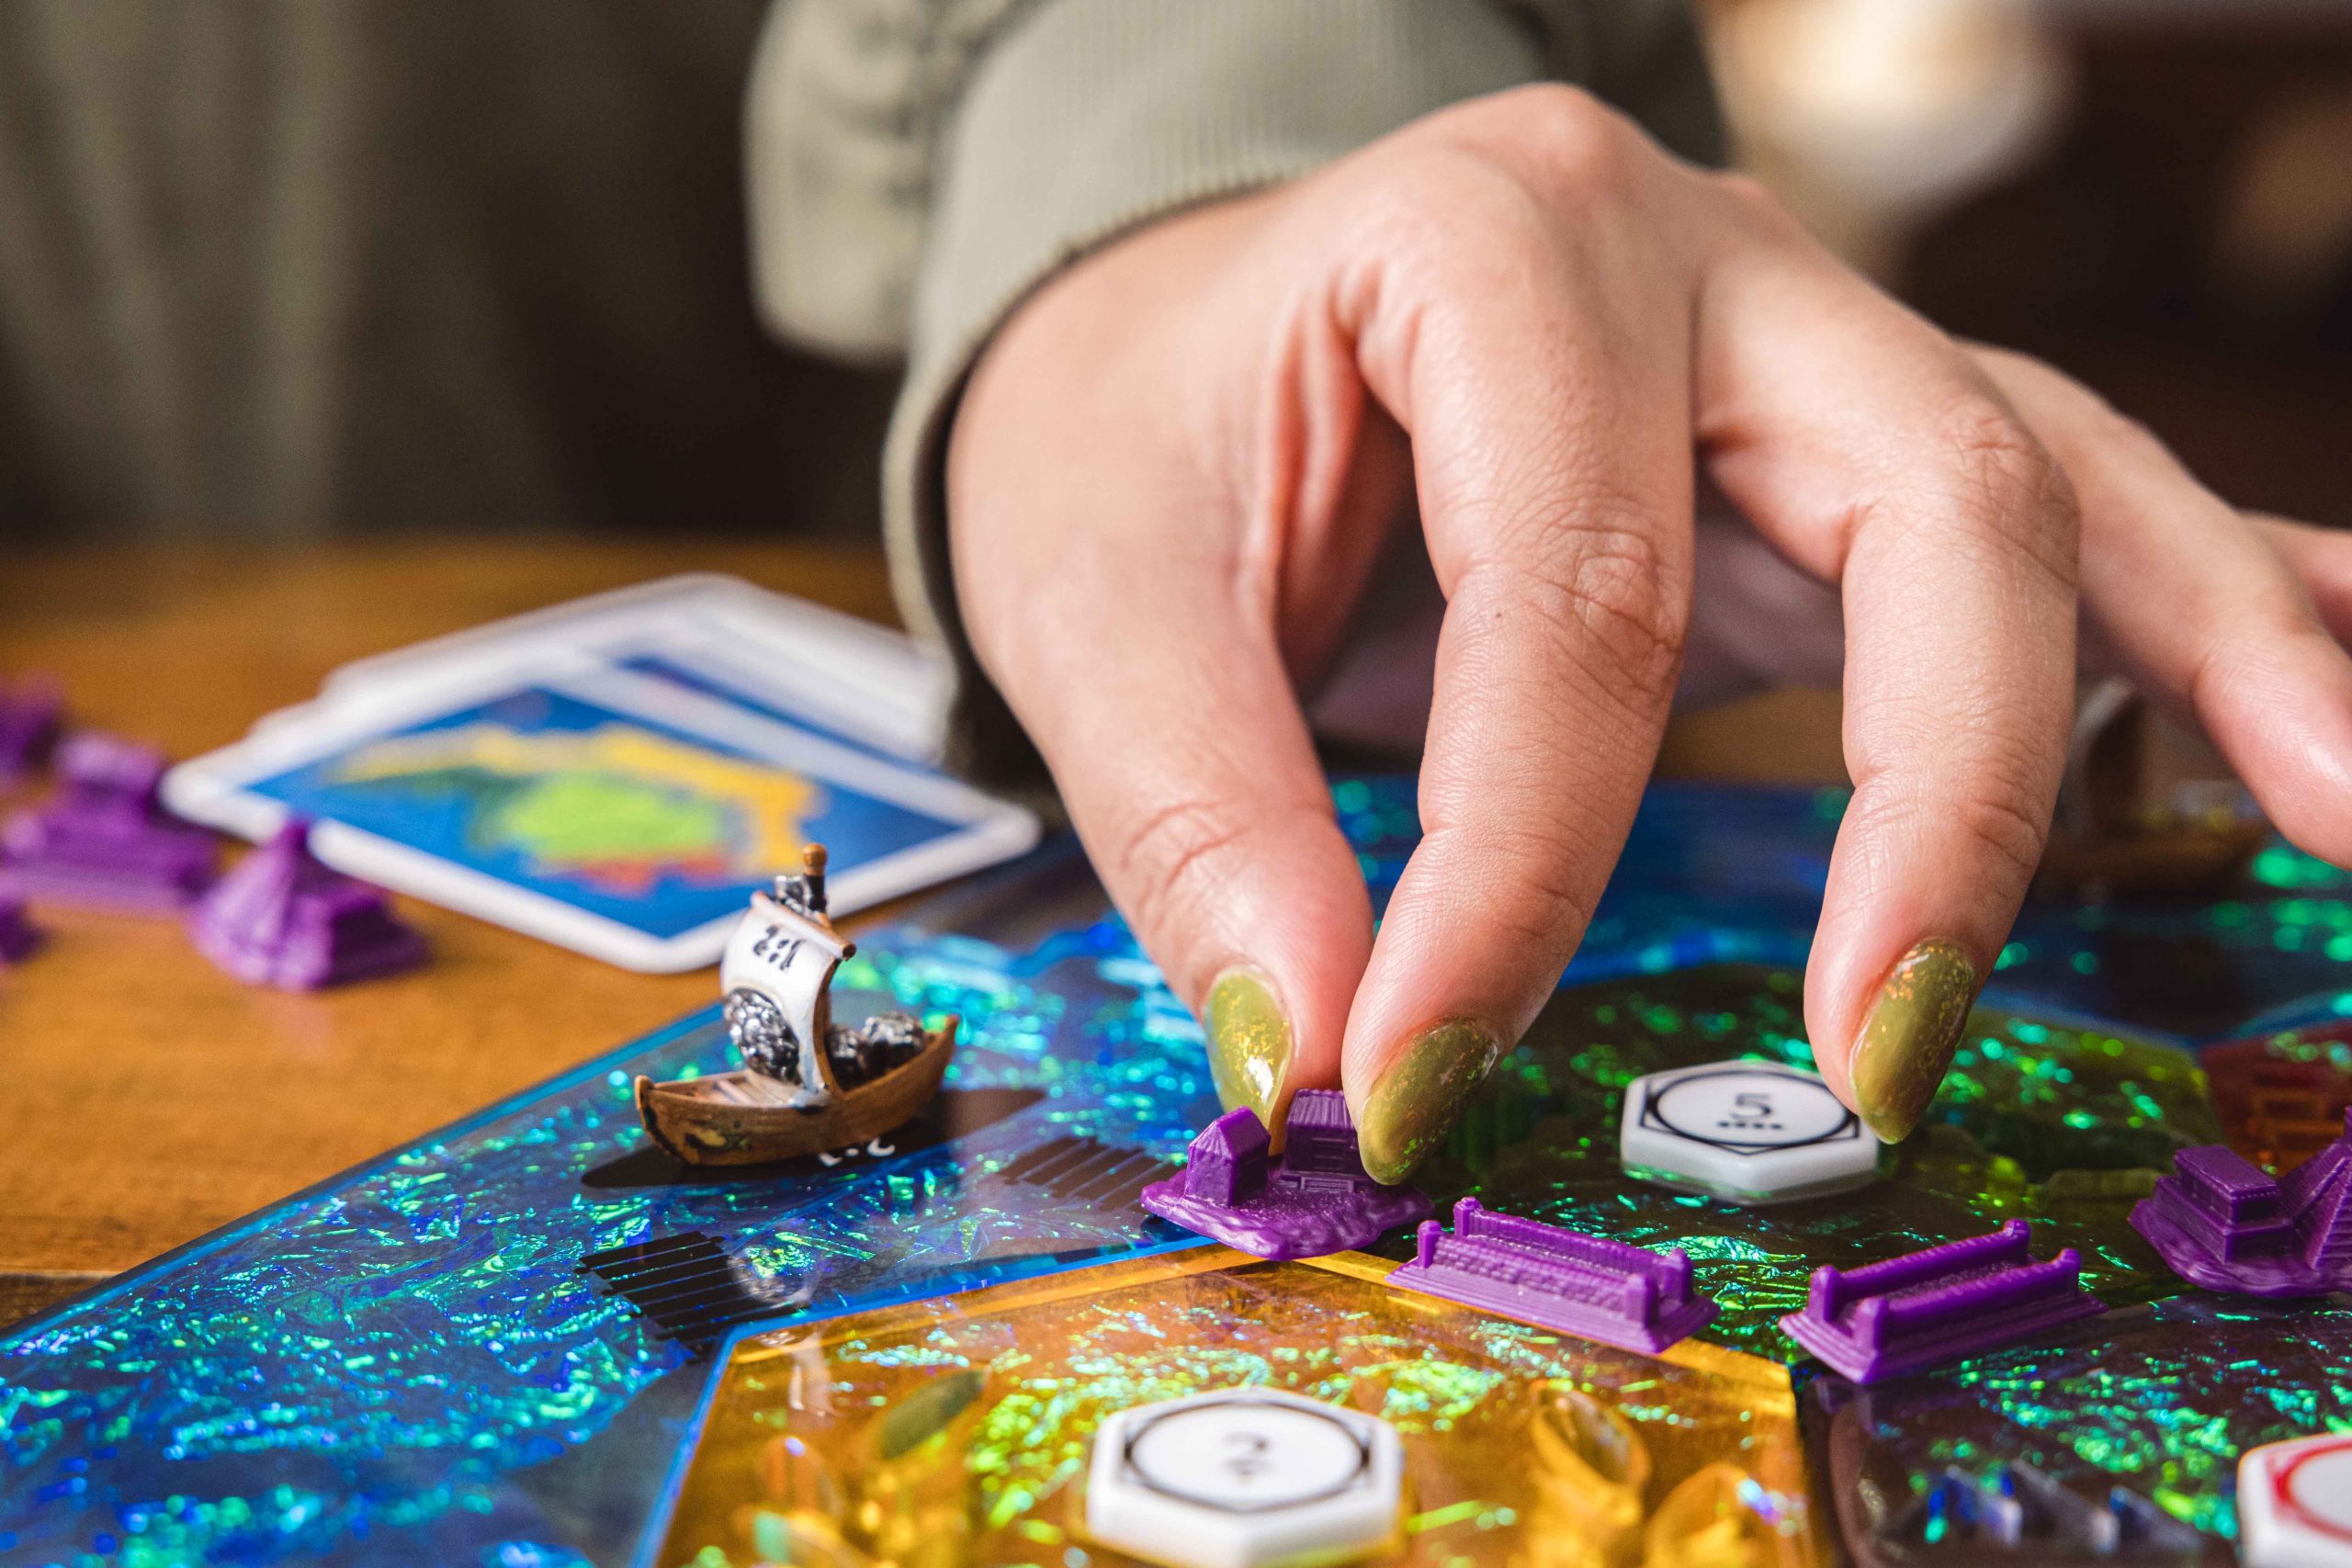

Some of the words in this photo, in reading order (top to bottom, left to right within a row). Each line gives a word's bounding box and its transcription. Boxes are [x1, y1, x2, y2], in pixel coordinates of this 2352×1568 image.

[752, 925, 807, 971] 2:1
[1730, 1092, 1772, 1121] 5
[1219, 1432, 1274, 1471] 2
